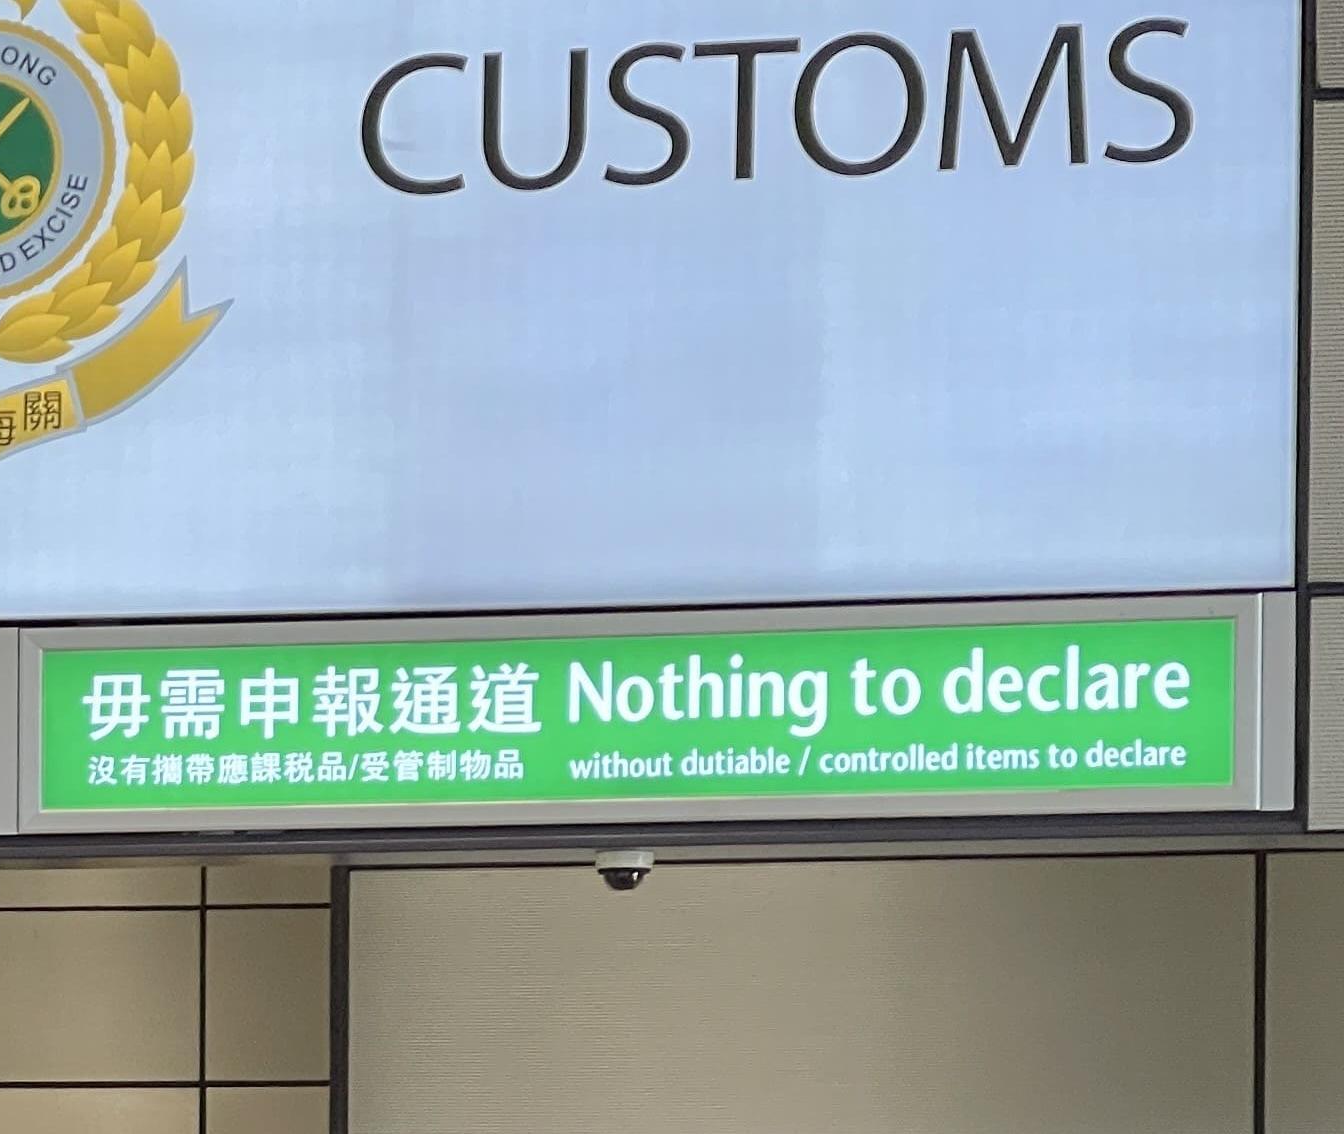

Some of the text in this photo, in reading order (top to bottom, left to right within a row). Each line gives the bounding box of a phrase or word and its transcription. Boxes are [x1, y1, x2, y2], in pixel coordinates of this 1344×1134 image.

[360, 17, 1194, 195] CUSTOMS
[18, 172, 89, 263] EXCISE
[81, 662, 543, 741] 毋需申報通道
[567, 644, 1190, 737] Nothing to declare
[569, 737, 1187, 780] without dutiable / controlled items to declare
